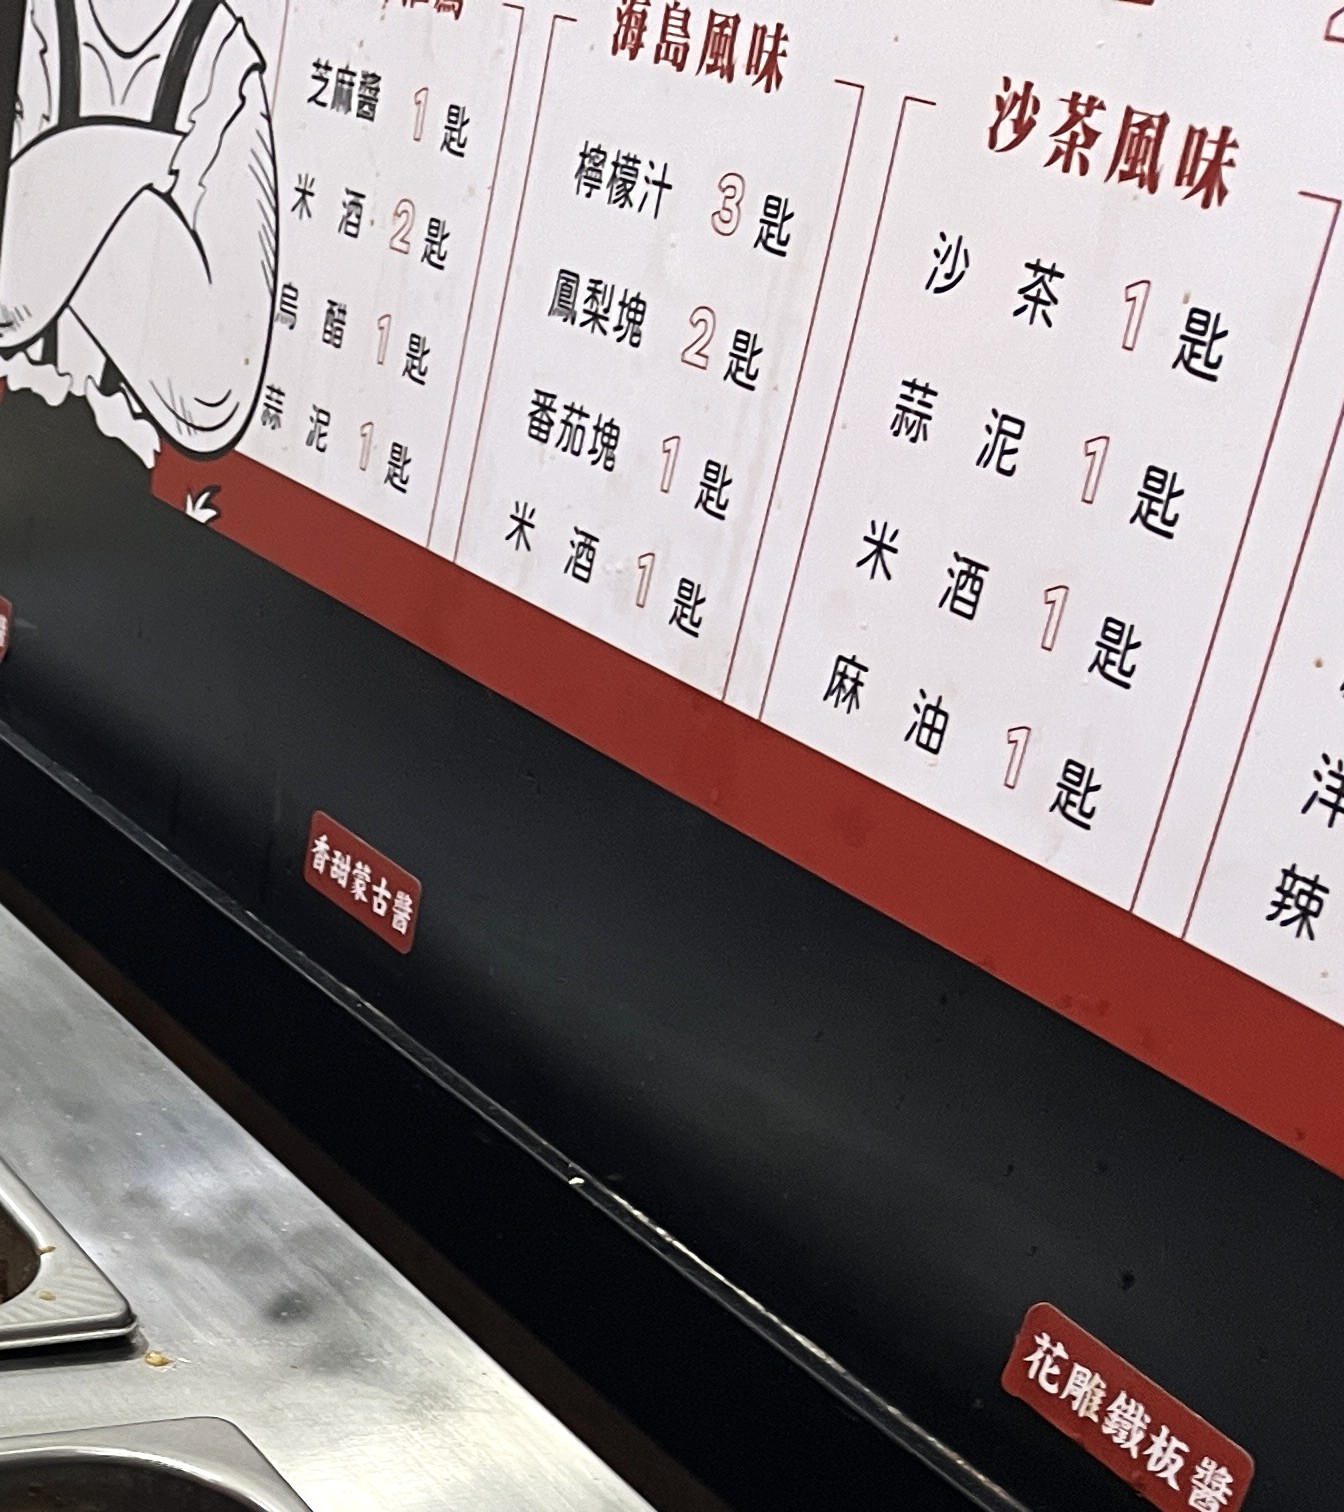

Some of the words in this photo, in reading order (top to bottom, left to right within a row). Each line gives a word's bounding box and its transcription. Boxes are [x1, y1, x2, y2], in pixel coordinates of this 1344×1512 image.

[611, 0, 789, 93] 海島風味
[307, 58, 381, 122] 芝麻醬
[575, 141, 672, 219] 檸檬汁
[988, 76, 1239, 209] 沙茶風味
[548, 269, 647, 348] 鳳梨塊
[528, 389, 620, 472] 番茄塊
[311, 834, 414, 935] 香甜蒙古醬
